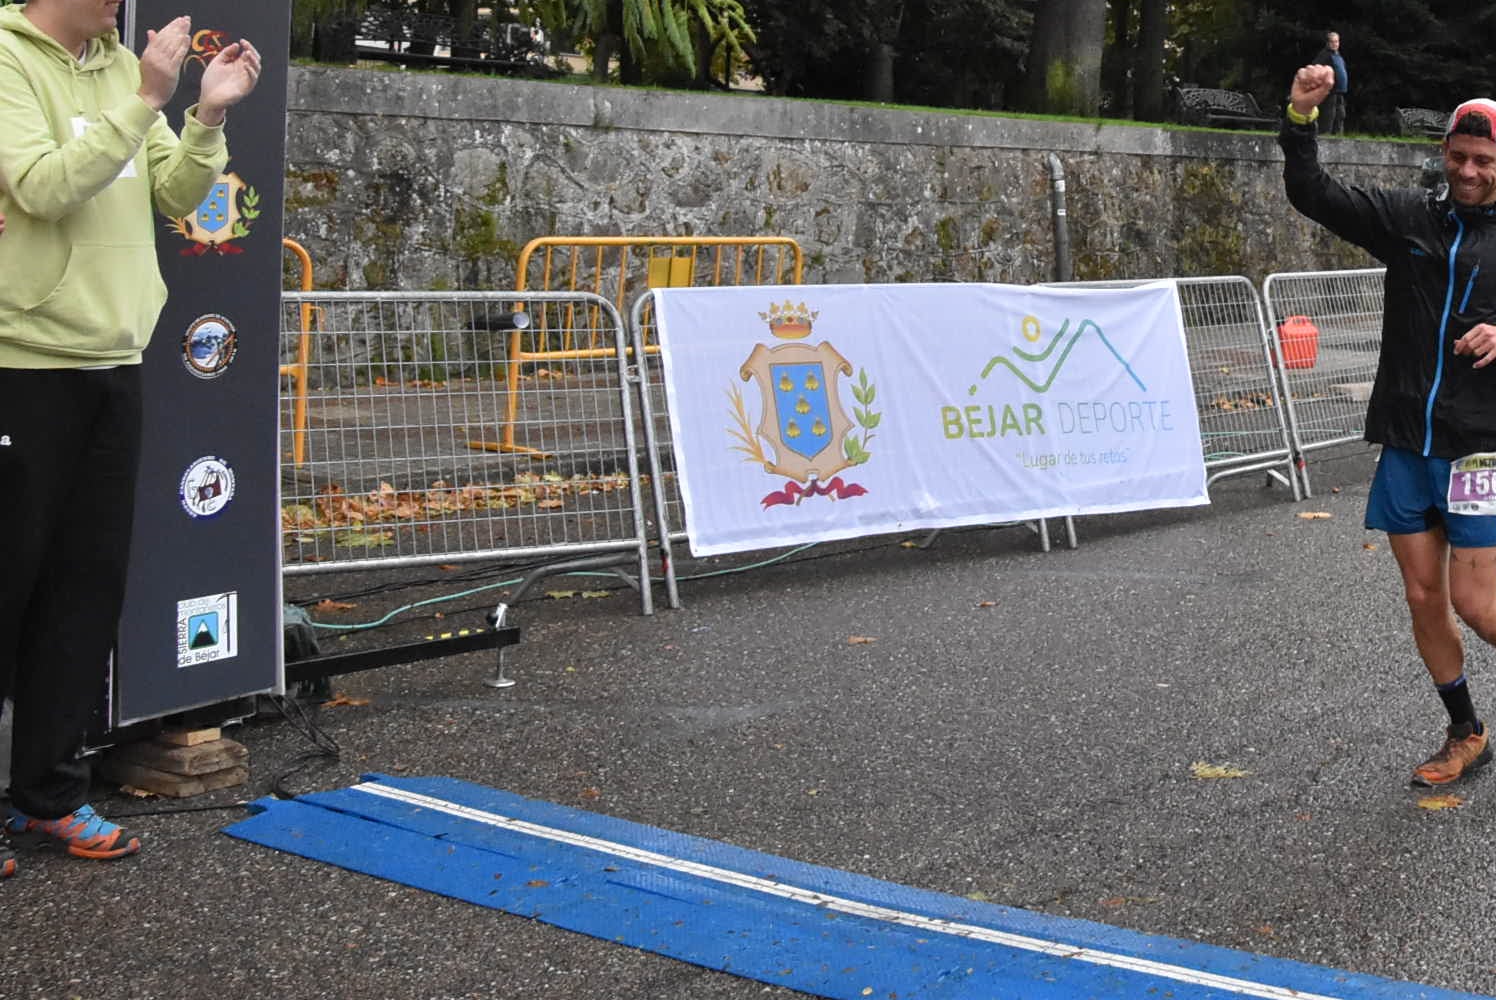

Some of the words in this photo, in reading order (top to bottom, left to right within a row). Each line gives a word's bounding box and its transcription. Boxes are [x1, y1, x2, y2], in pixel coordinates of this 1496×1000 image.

[941, 387, 1046, 441] BÉJAR
[1057, 400, 1174, 435] DEPORTE
[1064, 447, 1078, 465] de
[1079, 448, 1097, 465] tus
